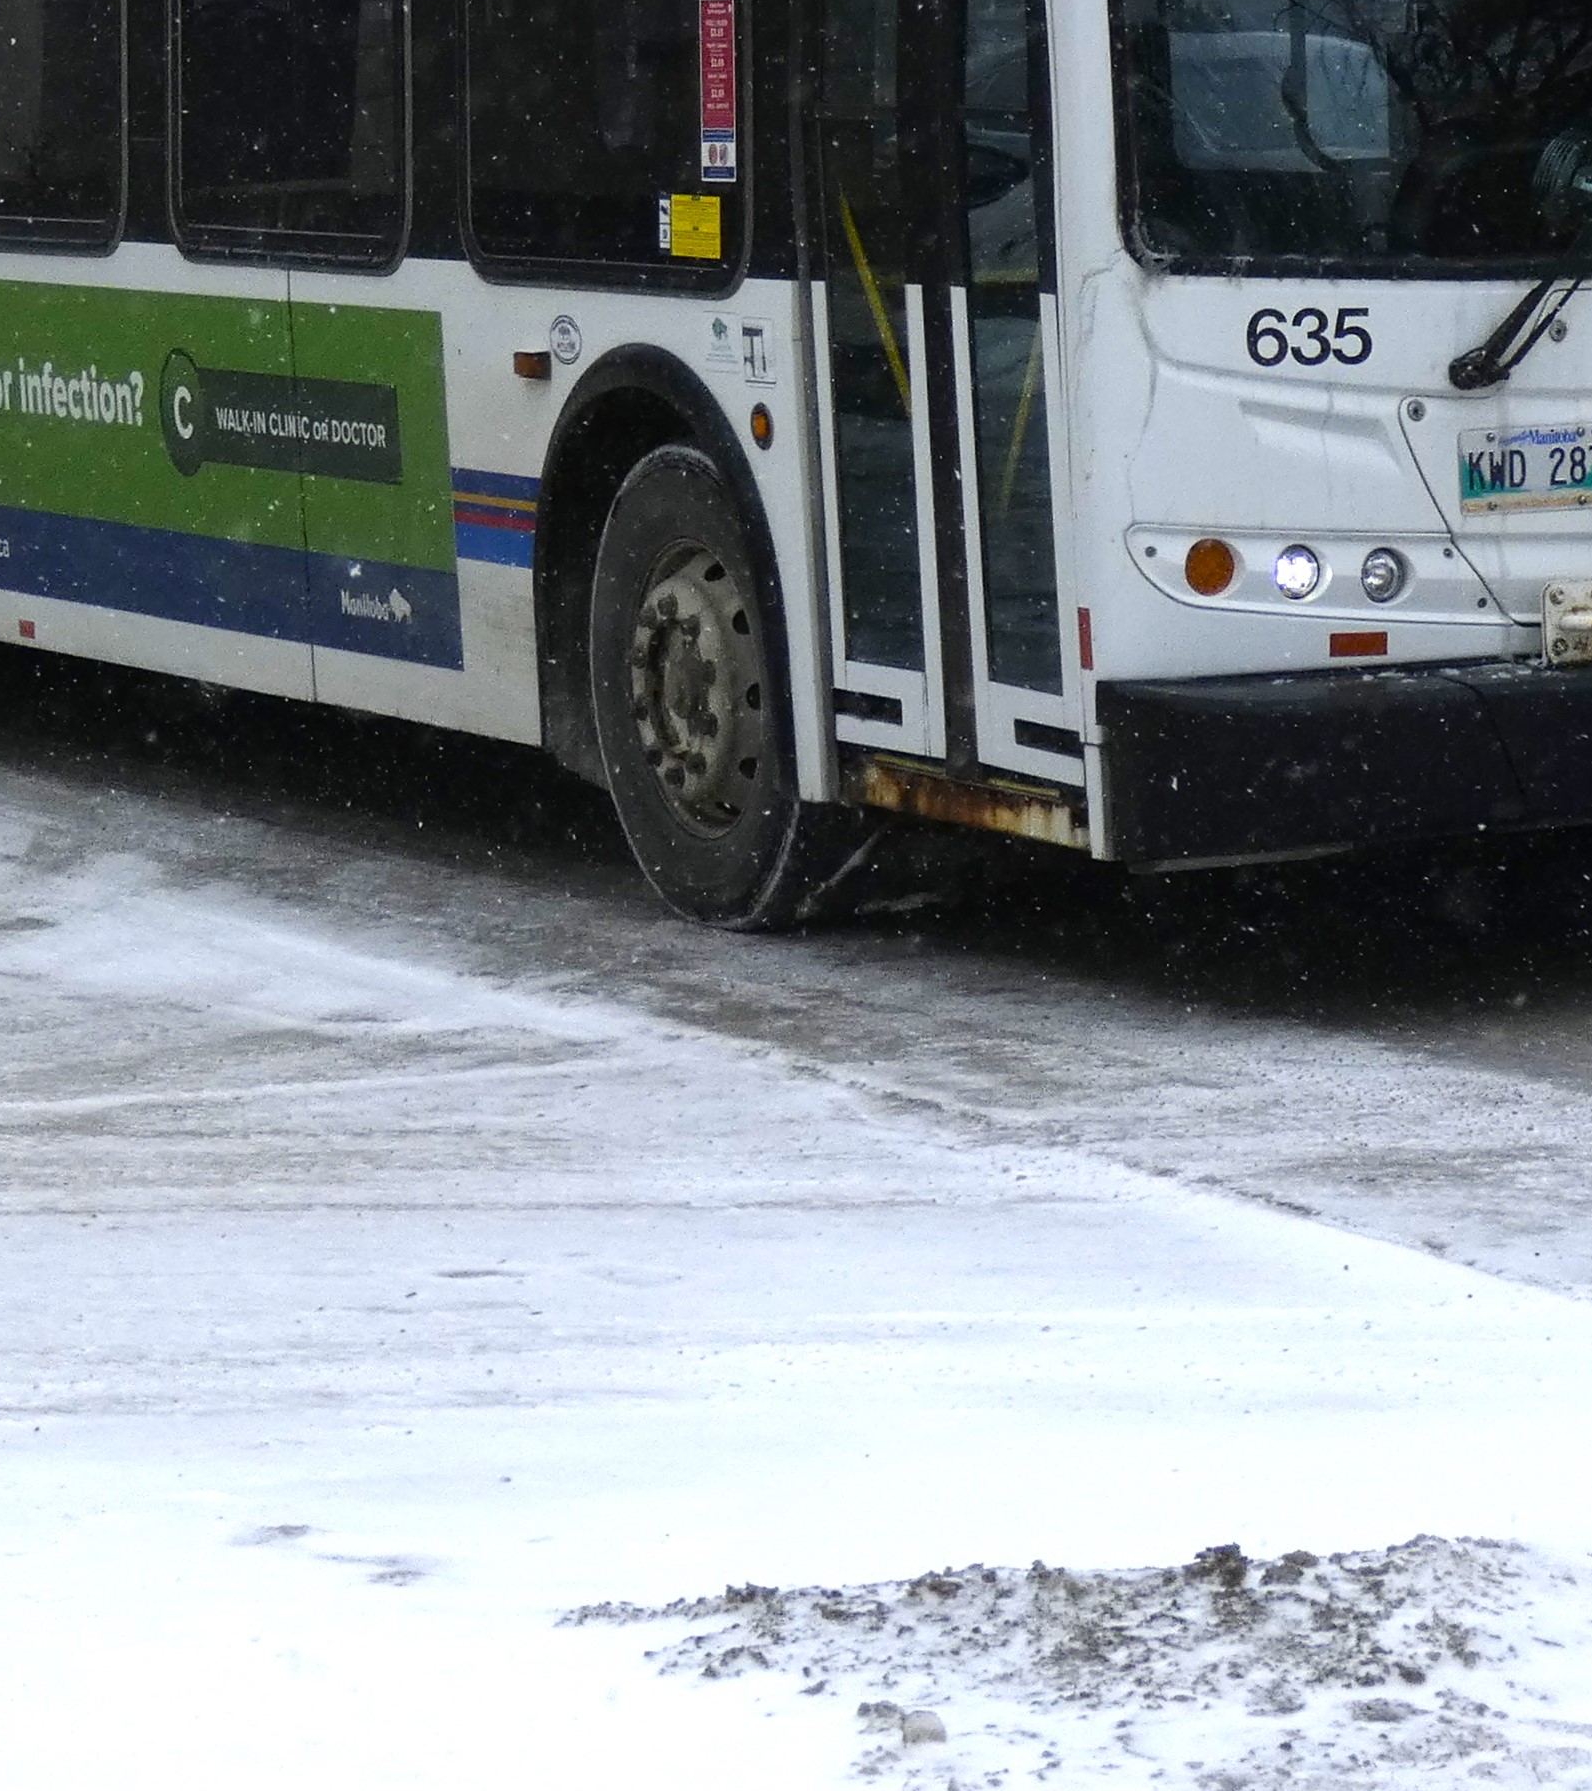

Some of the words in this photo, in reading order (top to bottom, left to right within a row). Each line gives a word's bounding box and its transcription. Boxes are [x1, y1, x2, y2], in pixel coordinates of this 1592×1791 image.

[1246, 307, 1373, 367] 635
[19, 357, 145, 427] infection?
[173, 386, 195, 440] C
[215, 407, 267, 434] WALK-IN
[269, 412, 310, 439] CLINIC
[332, 420, 387, 448] DOCTOR
[1468, 449, 1527, 491] KWD
